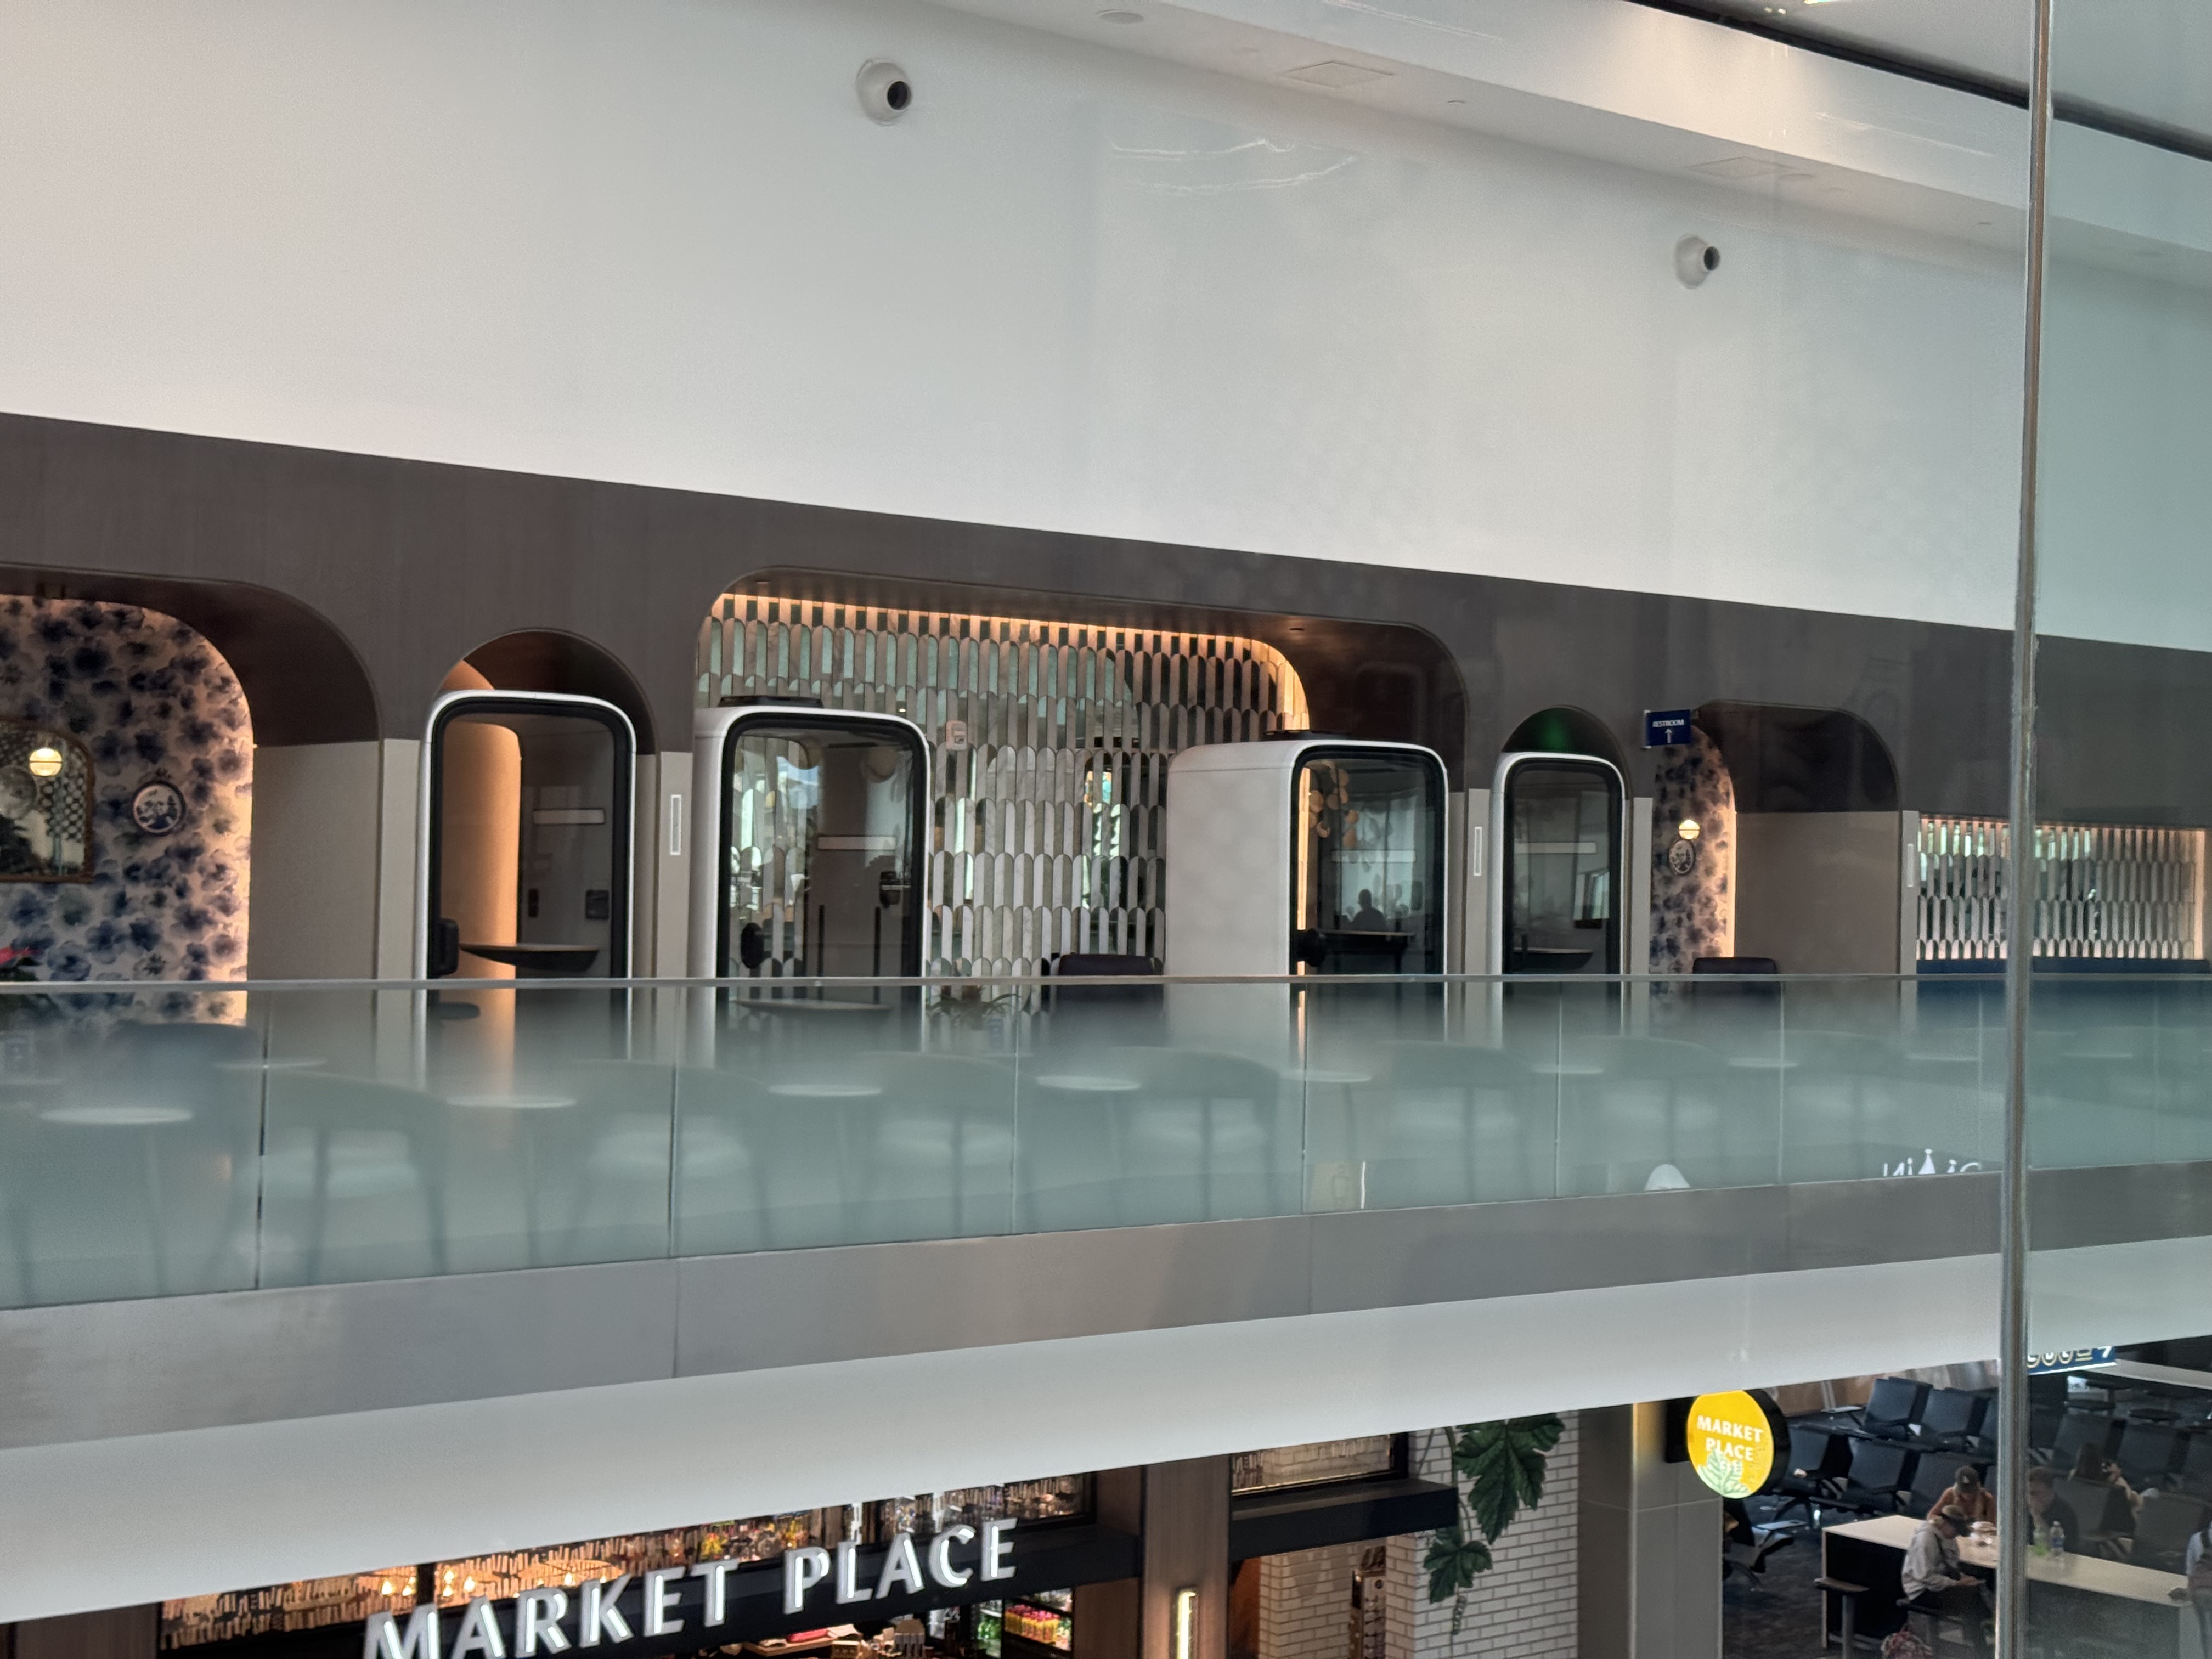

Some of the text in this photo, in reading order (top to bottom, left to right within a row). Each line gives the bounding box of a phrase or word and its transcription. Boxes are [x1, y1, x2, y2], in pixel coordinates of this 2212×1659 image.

[1652, 719, 1684, 727] RESTROOM
[1697, 1415, 1764, 1443] MARKET
[1706, 1437, 1754, 1462] PLACE
[363, 1518, 1018, 1659] MARKET PLACE
